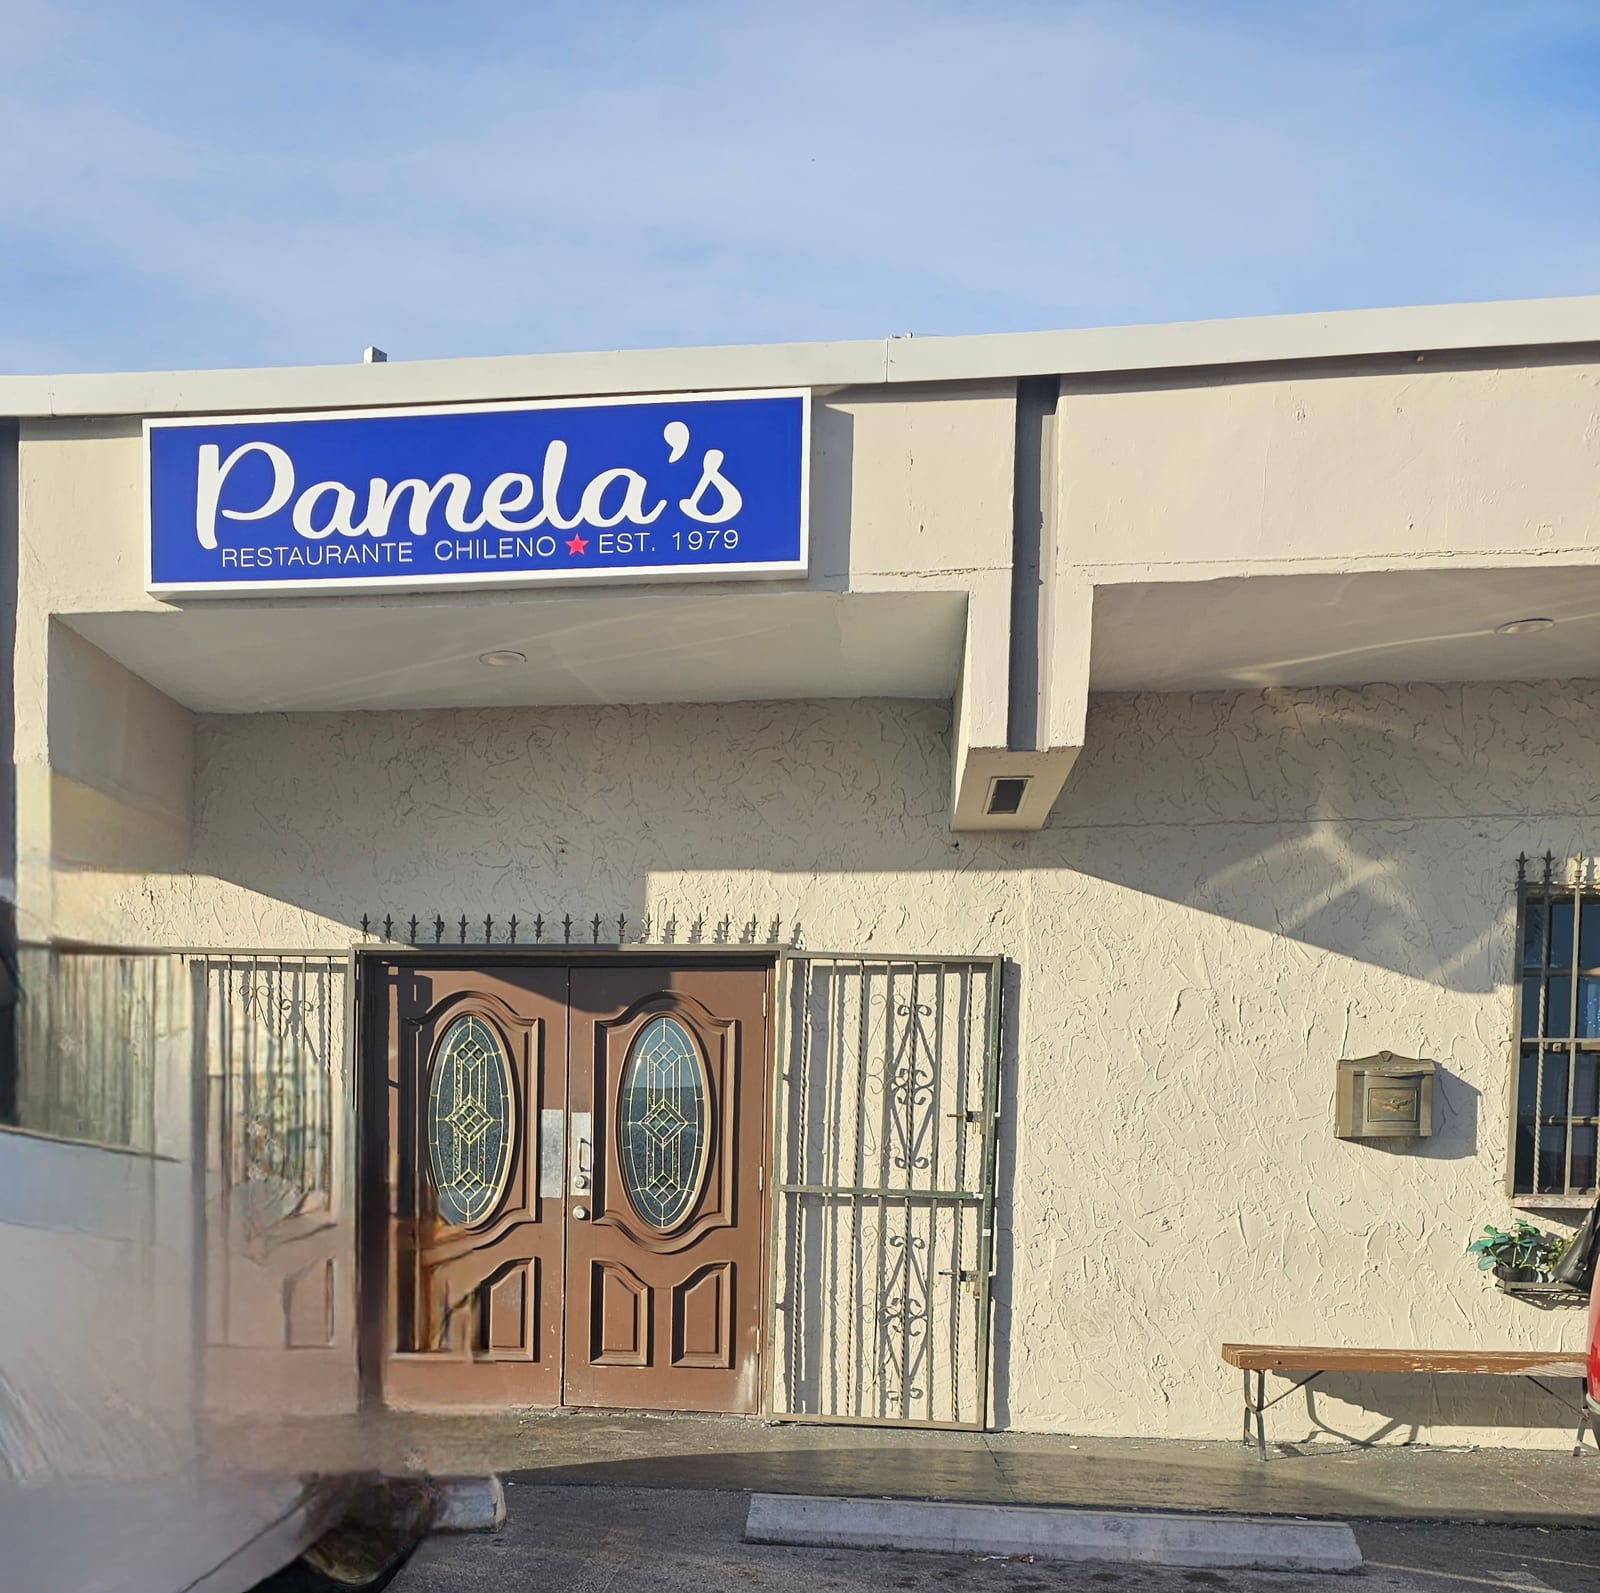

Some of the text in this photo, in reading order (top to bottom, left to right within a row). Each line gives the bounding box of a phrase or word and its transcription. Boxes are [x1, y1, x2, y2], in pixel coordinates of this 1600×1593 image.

[196, 421, 743, 550] Pamela's
[222, 529, 739, 568] RESTAURANTE CHILENO EST. 1979
